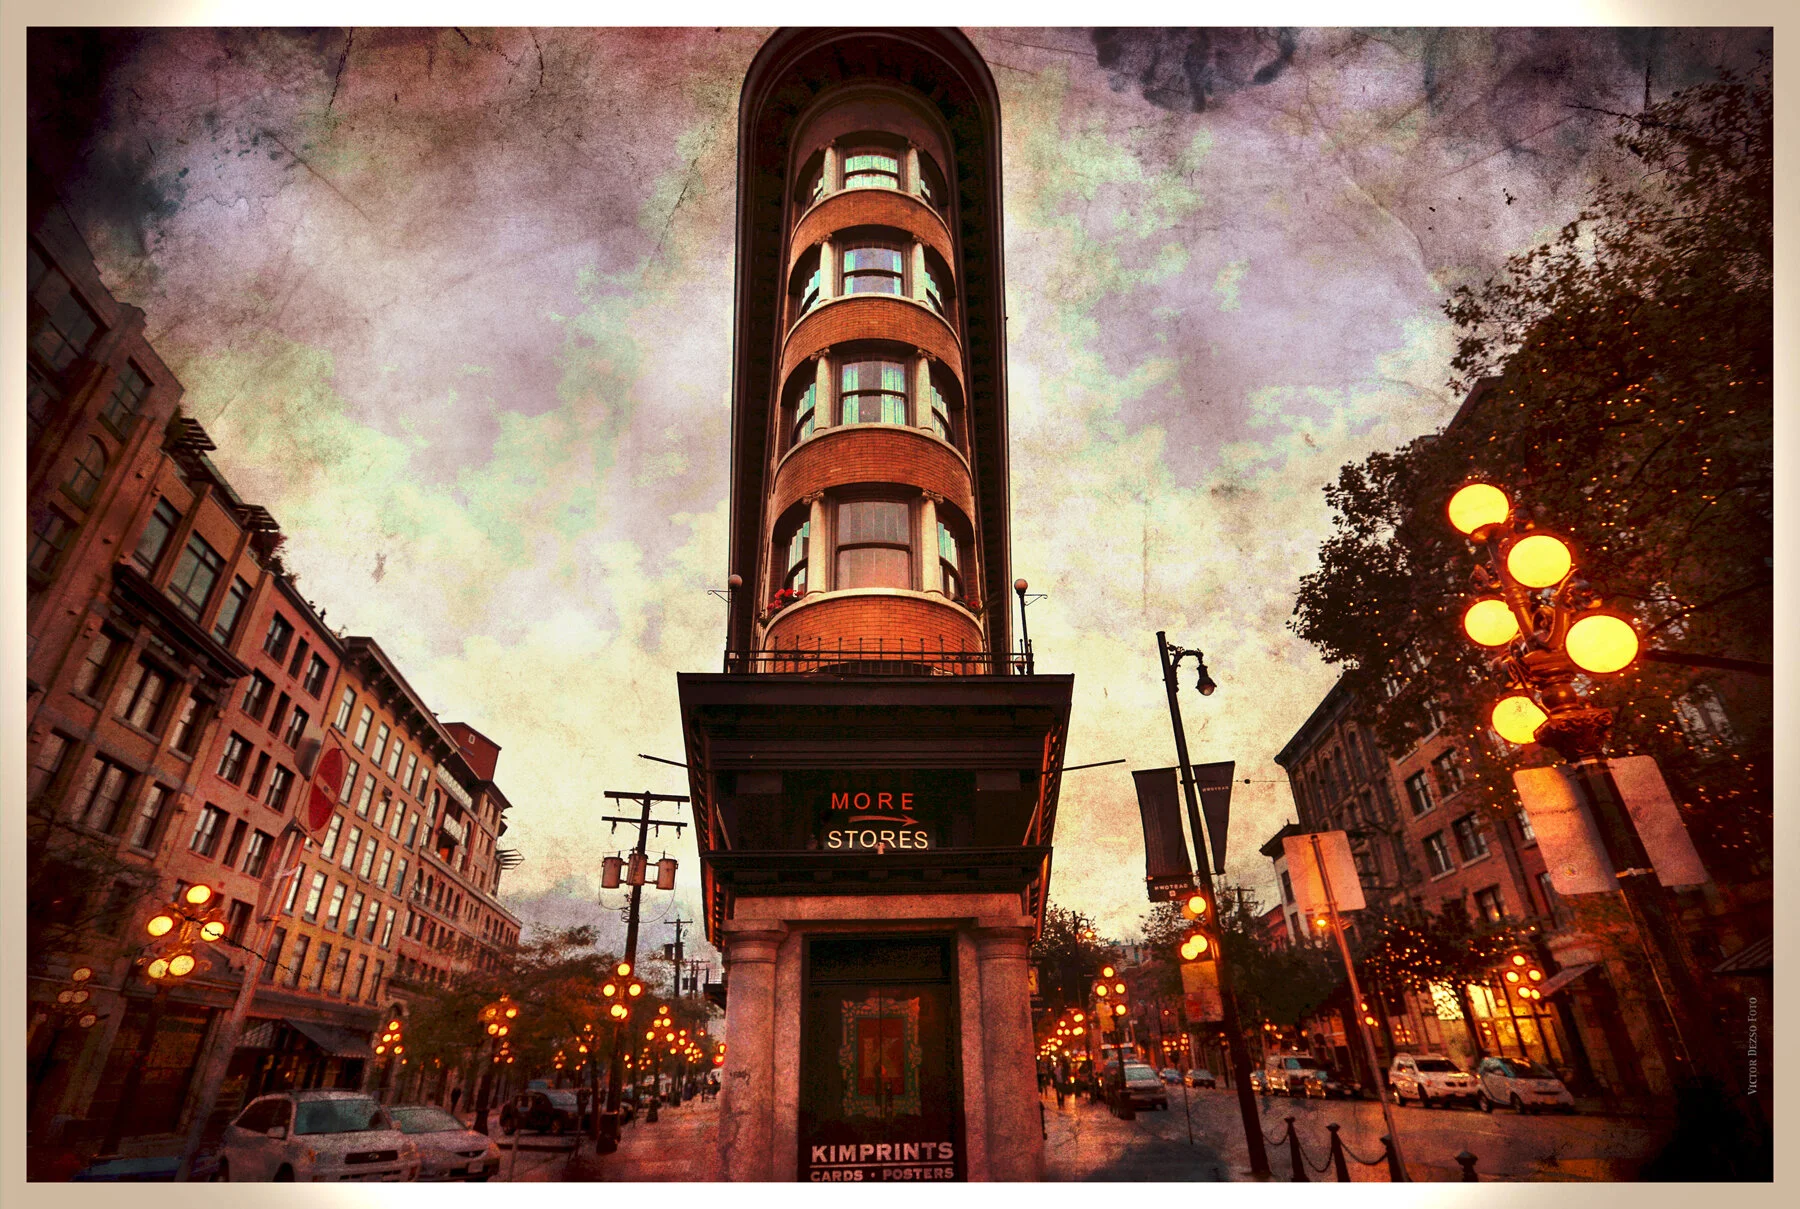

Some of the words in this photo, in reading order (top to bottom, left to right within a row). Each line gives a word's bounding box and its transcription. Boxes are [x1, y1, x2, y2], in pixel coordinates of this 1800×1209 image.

[831, 792, 914, 810] MORE
[827, 829, 929, 849] STORES
[811, 1142, 954, 1163] KIMPRINTS
[810, 1169, 863, 1182] CARDS
[882, 1167, 954, 1180] POSTERS
